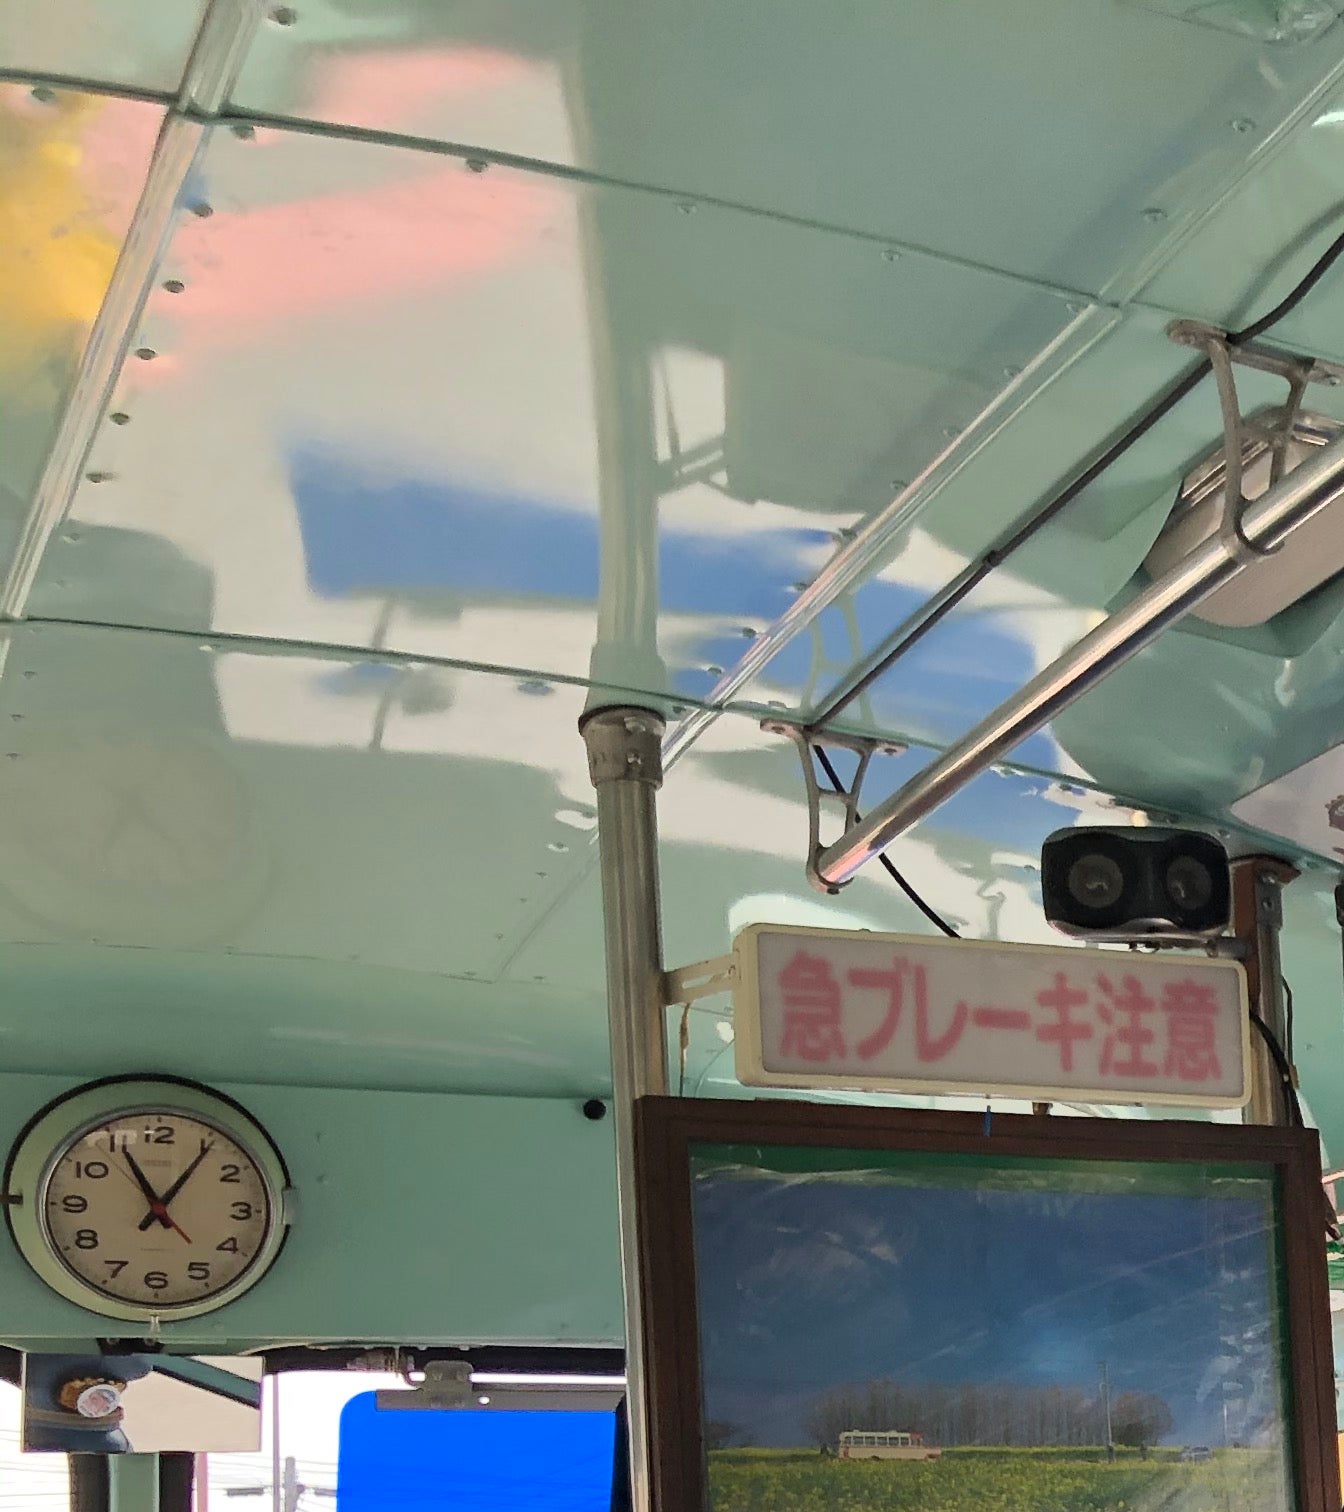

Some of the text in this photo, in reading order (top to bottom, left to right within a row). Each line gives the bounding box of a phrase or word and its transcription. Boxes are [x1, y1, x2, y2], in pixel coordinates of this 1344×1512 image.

[777, 950, 1222, 1081] 急ブレーキ注意
[144, 1126, 175, 1145] 12
[76, 1161, 109, 1179] 10
[220, 1164, 241, 1183] 2
[62, 1195, 88, 1213] 9
[230, 1202, 252, 1220] 3
[75, 1229, 99, 1249] 8
[216, 1237, 240, 1253] 4
[104, 1260, 129, 1279] 7
[187, 1262, 210, 1280] 5
[144, 1271, 169, 1289] 6
